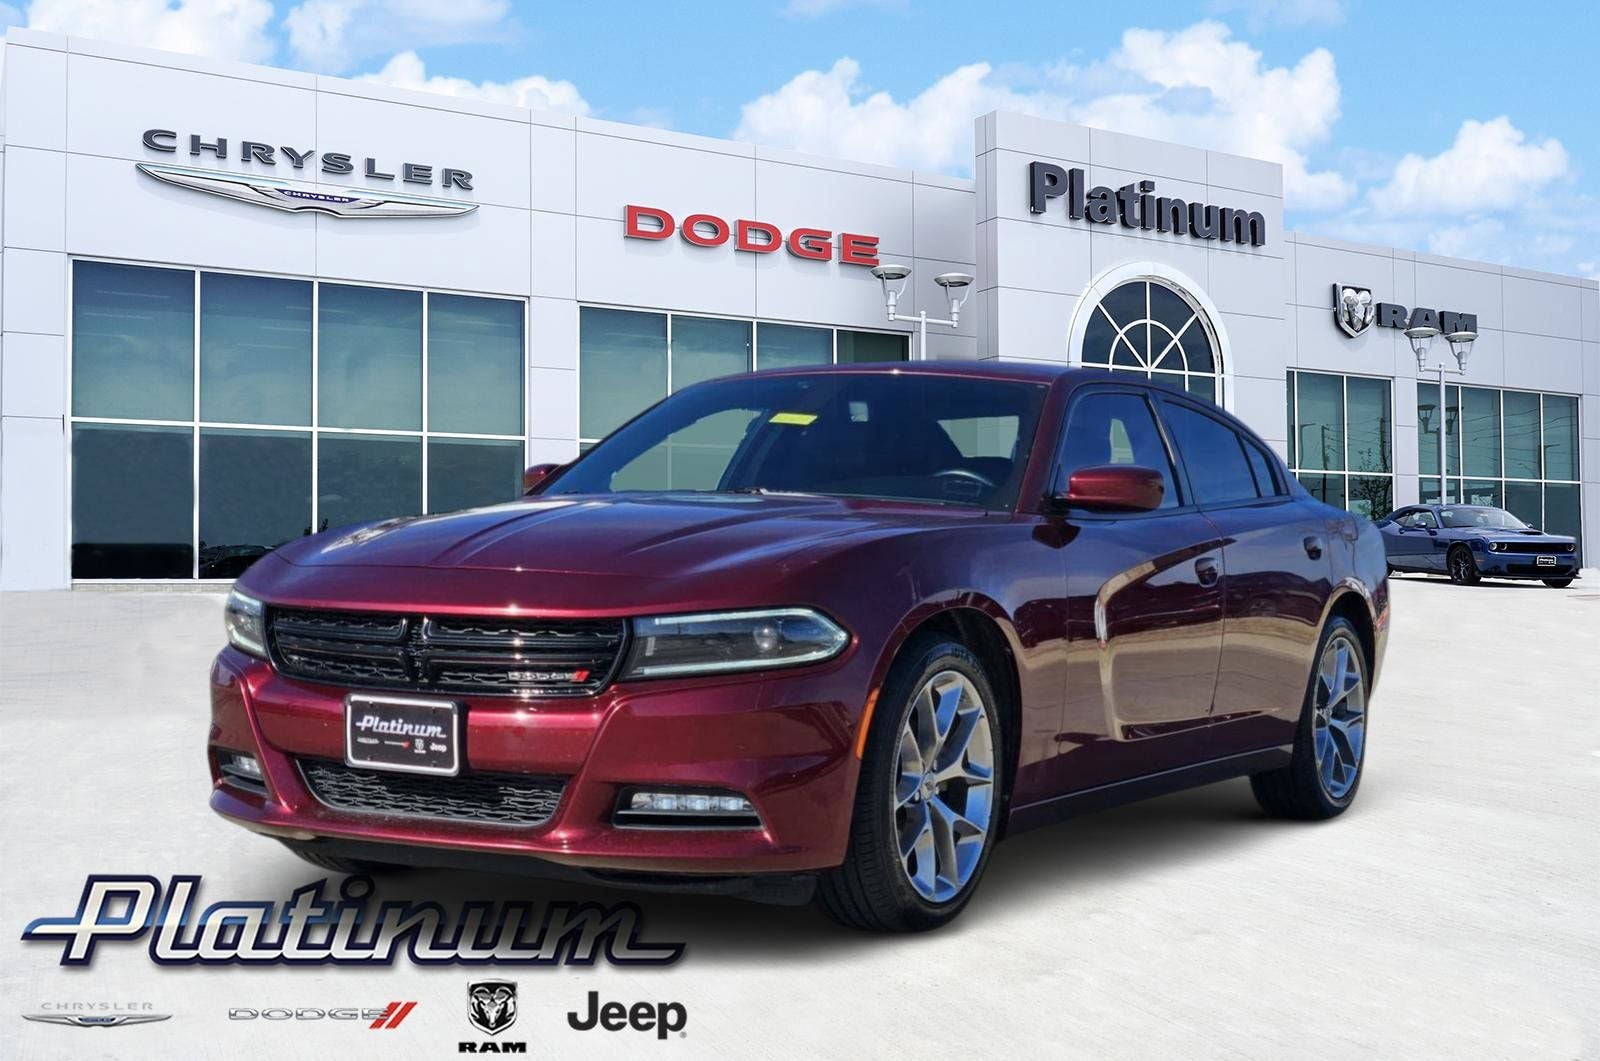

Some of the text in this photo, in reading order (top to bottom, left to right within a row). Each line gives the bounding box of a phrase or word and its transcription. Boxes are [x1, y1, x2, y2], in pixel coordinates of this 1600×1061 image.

[142, 128, 474, 190] CHRYSLER
[284, 190, 350, 203] CHRYSLER
[1028, 161, 1267, 246] Platinum
[623, 205, 881, 266] DODGE
[1376, 303, 1477, 334] RAM
[356, 714, 447, 739] Platinum
